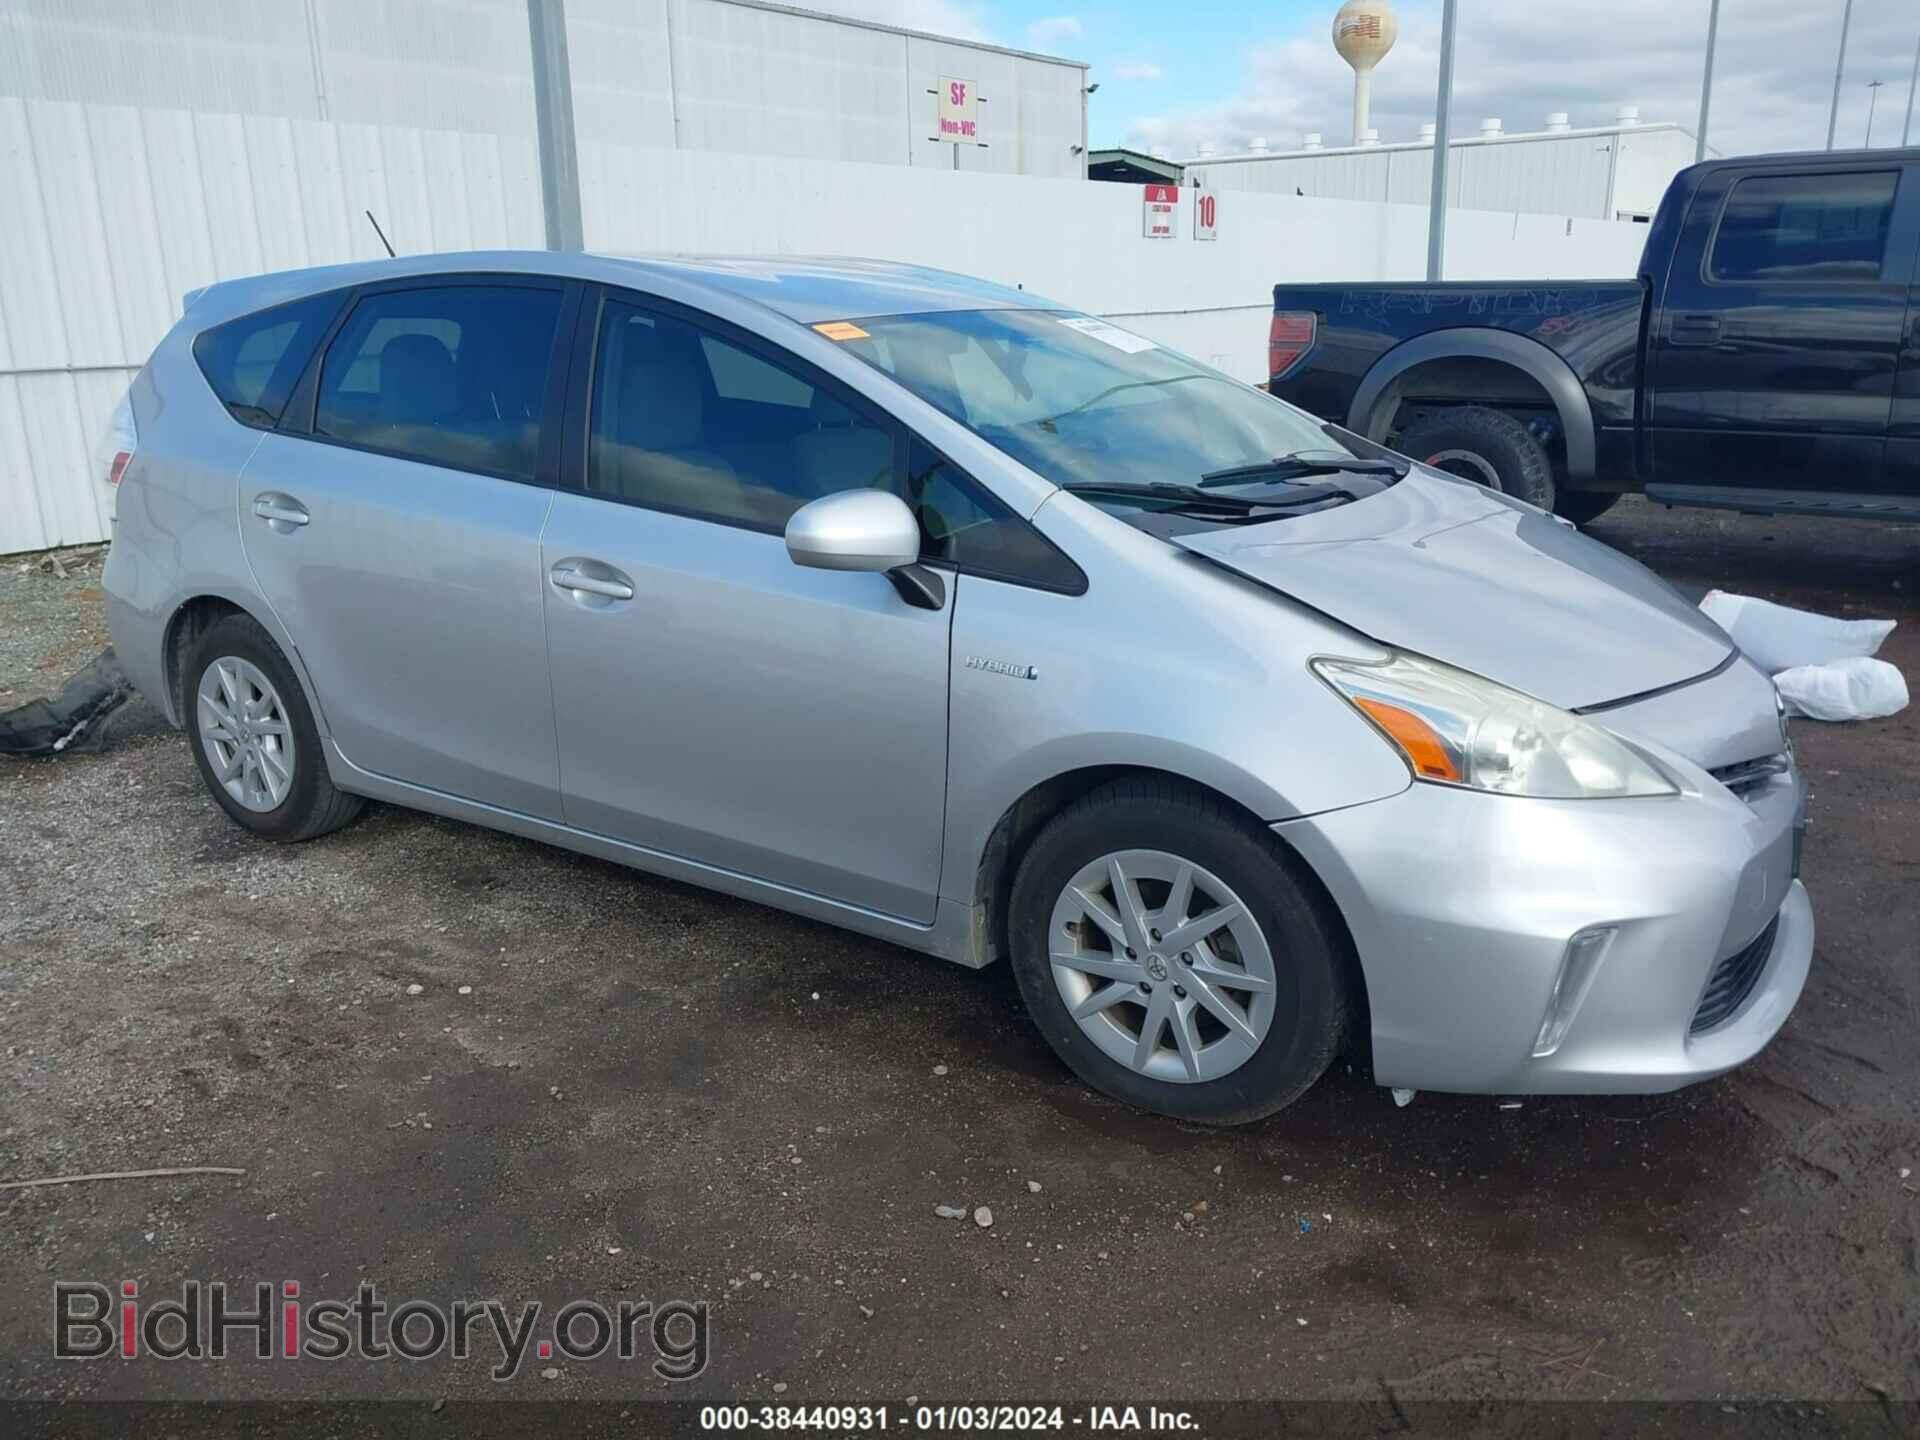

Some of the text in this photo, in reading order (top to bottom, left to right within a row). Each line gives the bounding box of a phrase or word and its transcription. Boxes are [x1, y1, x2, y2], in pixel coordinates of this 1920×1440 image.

[950, 82, 966, 106] SF
[940, 117, 976, 137] Non-VIC
[1198, 195, 1216, 228] 10
